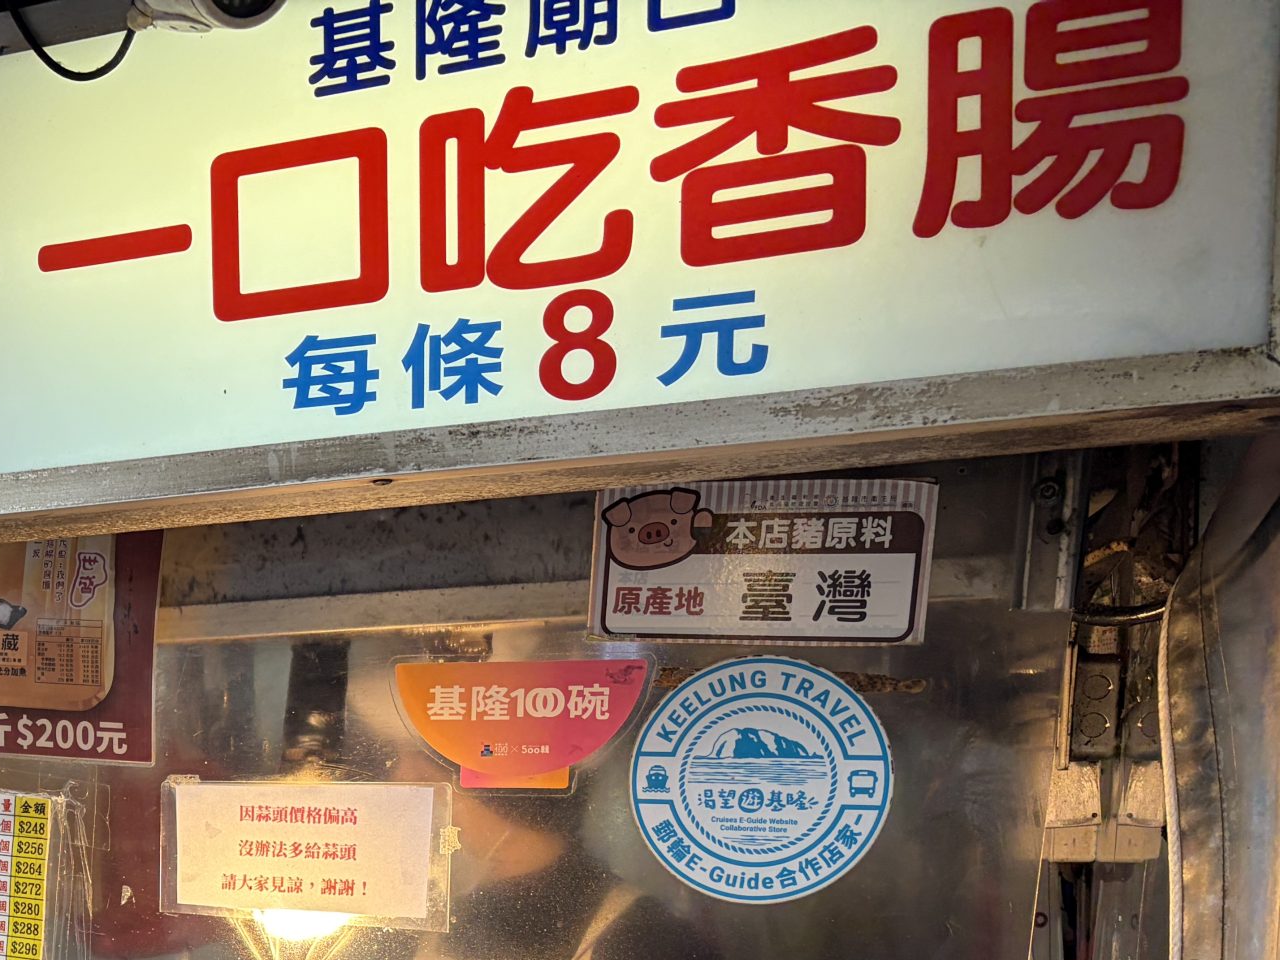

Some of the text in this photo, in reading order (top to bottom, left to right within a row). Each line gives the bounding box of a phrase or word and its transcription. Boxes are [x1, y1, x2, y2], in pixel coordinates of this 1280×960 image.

[308, 0, 738, 98] 基隆廟
[36, 0, 1190, 322] 一口吃香腸
[725, 515, 893, 550] 本店豬原料
[612, 585, 705, 616] 原產地
[739, 569, 872, 623] 臺灣
[426, 683, 610, 722] 基隆100碗
[655, 670, 867, 747] KEELUNG TRAVEL
[19, 800, 46, 816] 金額
[239, 805, 358, 826] 因蒜頭價格偏高
[18, 820, 45, 836] $248
[711, 815, 798, 826] Cruises E-Guide Website
[720, 824, 788, 834] Collaborative Store
[16, 840, 44, 856] $256
[238, 839, 357, 861] 沒辦法多給蒜頭
[15, 860, 42, 876] $264
[14, 880, 41, 896] $272
[13, 899, 40, 915] $280
[11, 919, 39, 935] $288
[10, 939, 37, 955] $296
